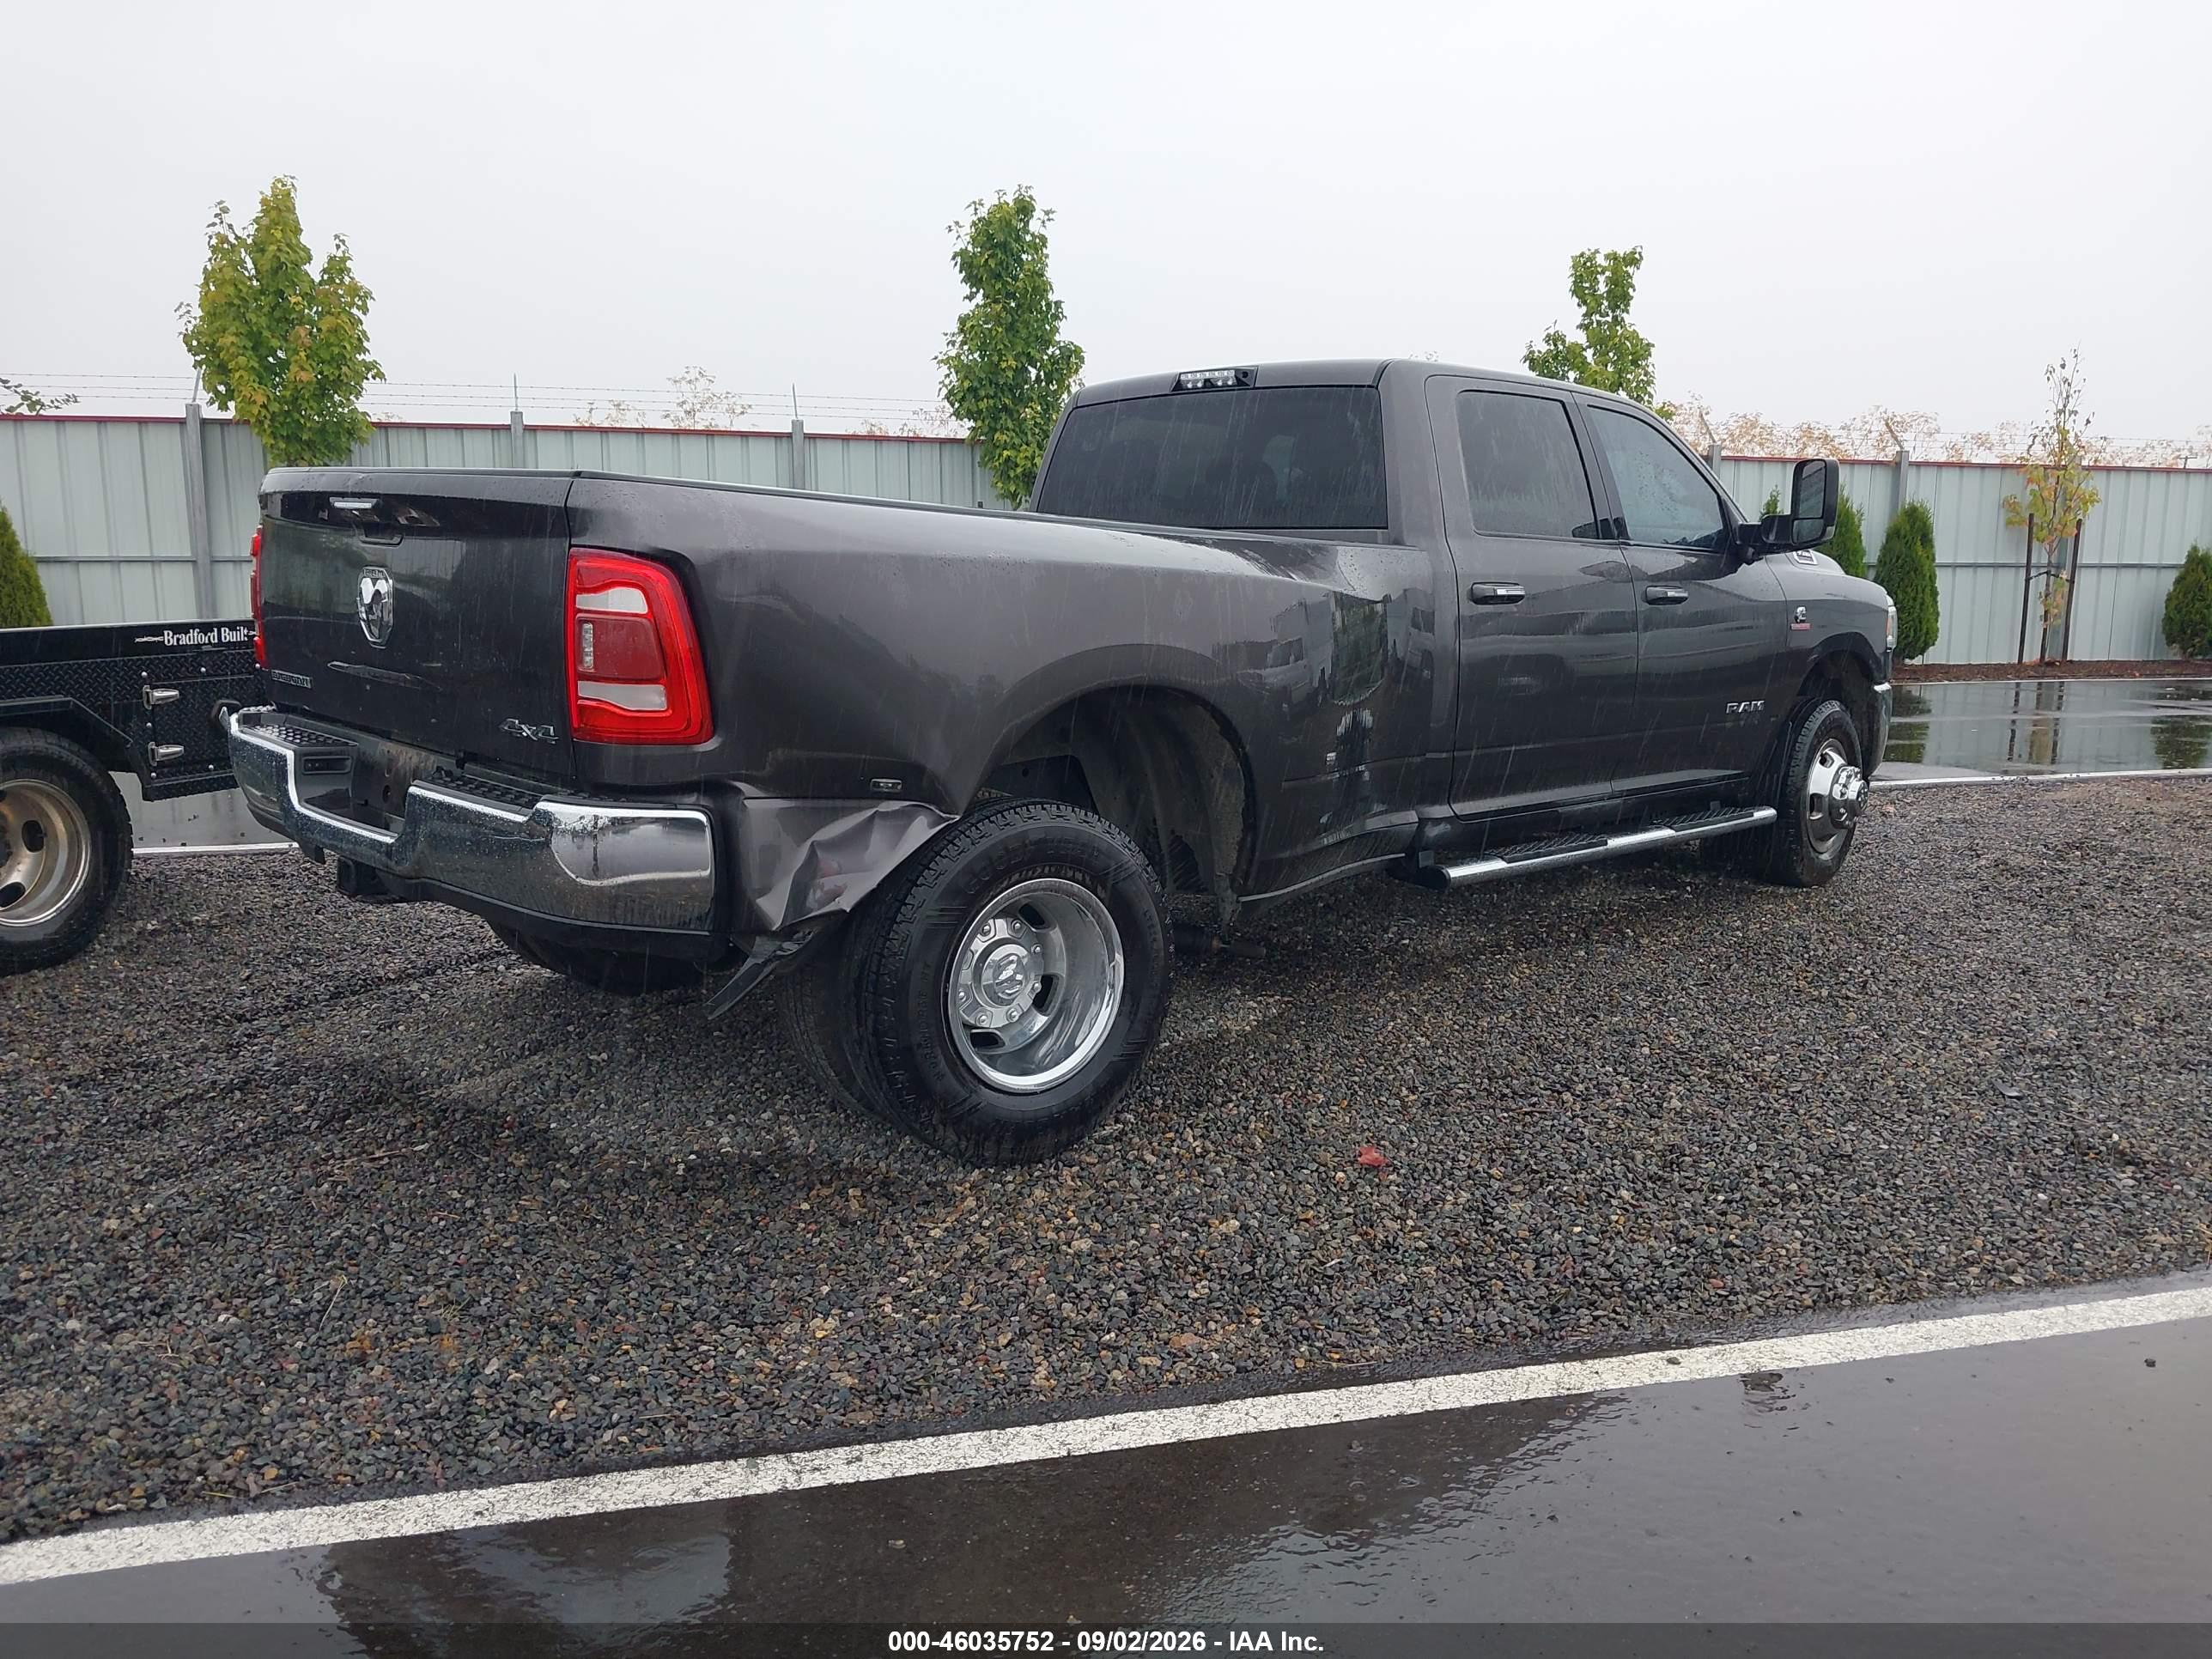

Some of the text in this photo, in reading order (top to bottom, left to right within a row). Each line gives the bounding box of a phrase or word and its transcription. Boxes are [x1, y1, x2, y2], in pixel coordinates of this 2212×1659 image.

[163, 626, 248, 647] Bradford Built
[1726, 701, 1765, 714] RAM
